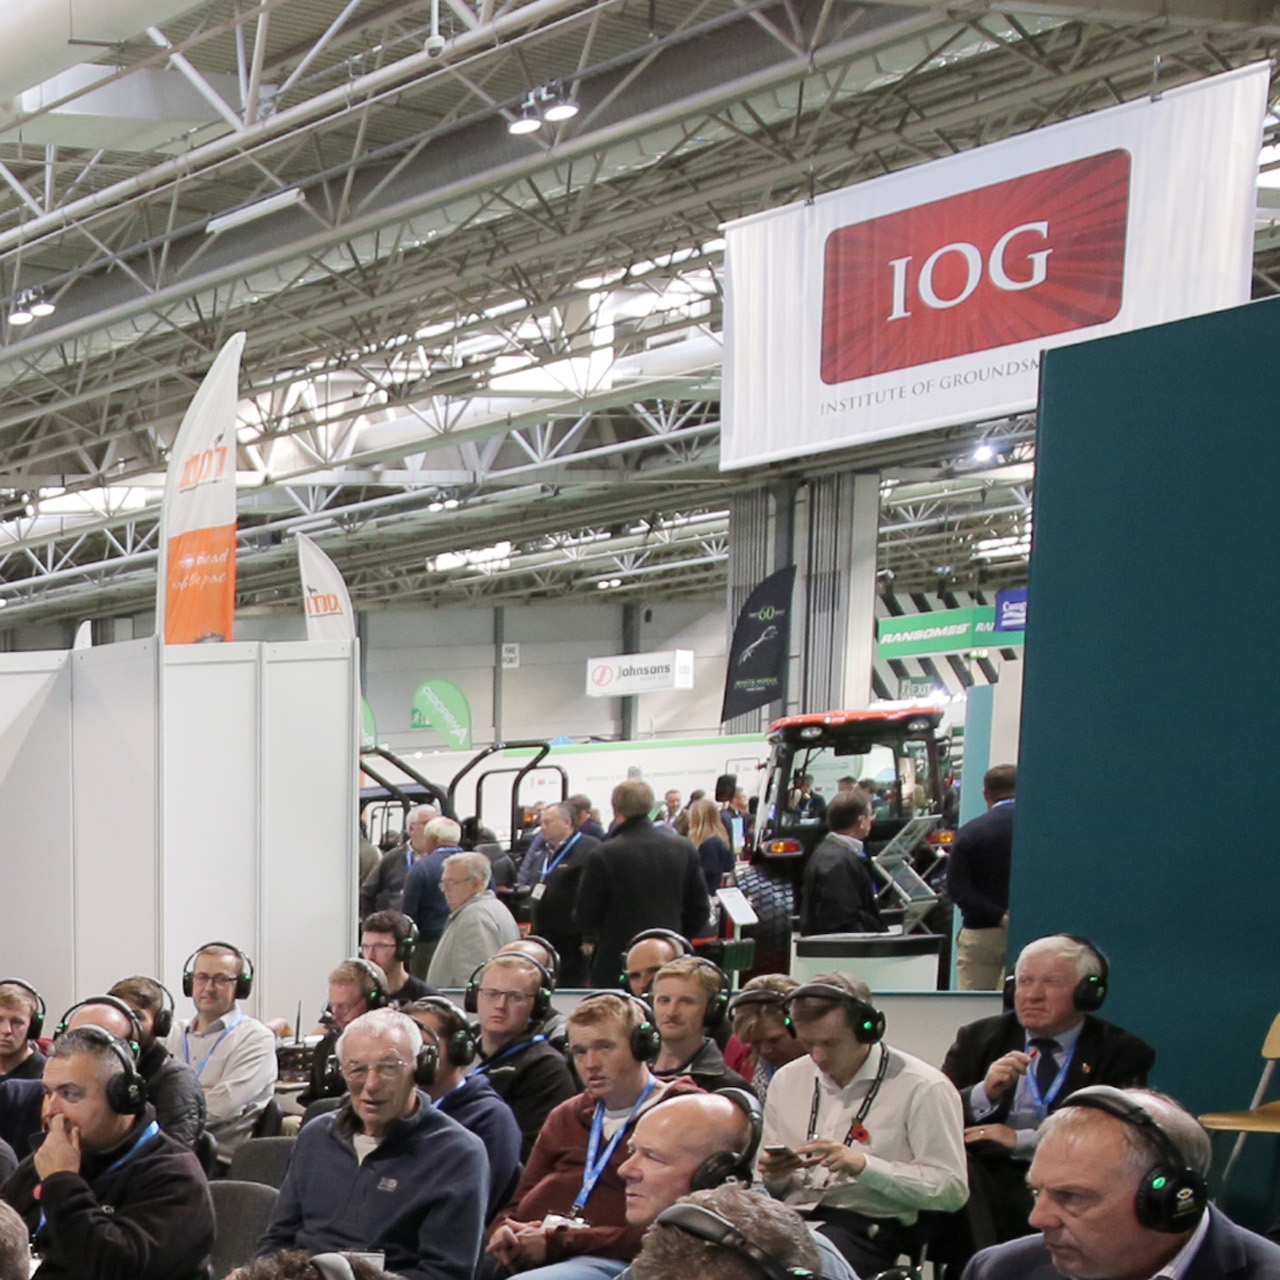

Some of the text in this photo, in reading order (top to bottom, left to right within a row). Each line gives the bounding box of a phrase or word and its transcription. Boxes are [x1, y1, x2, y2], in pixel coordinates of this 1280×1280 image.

[886, 221, 1054, 322] IOG
[820, 386, 908, 416] INSTITUTE
[912, 379, 935, 396] OF
[880, 623, 970, 644] RANSOMES
[616, 663, 671, 681] Johnsons
